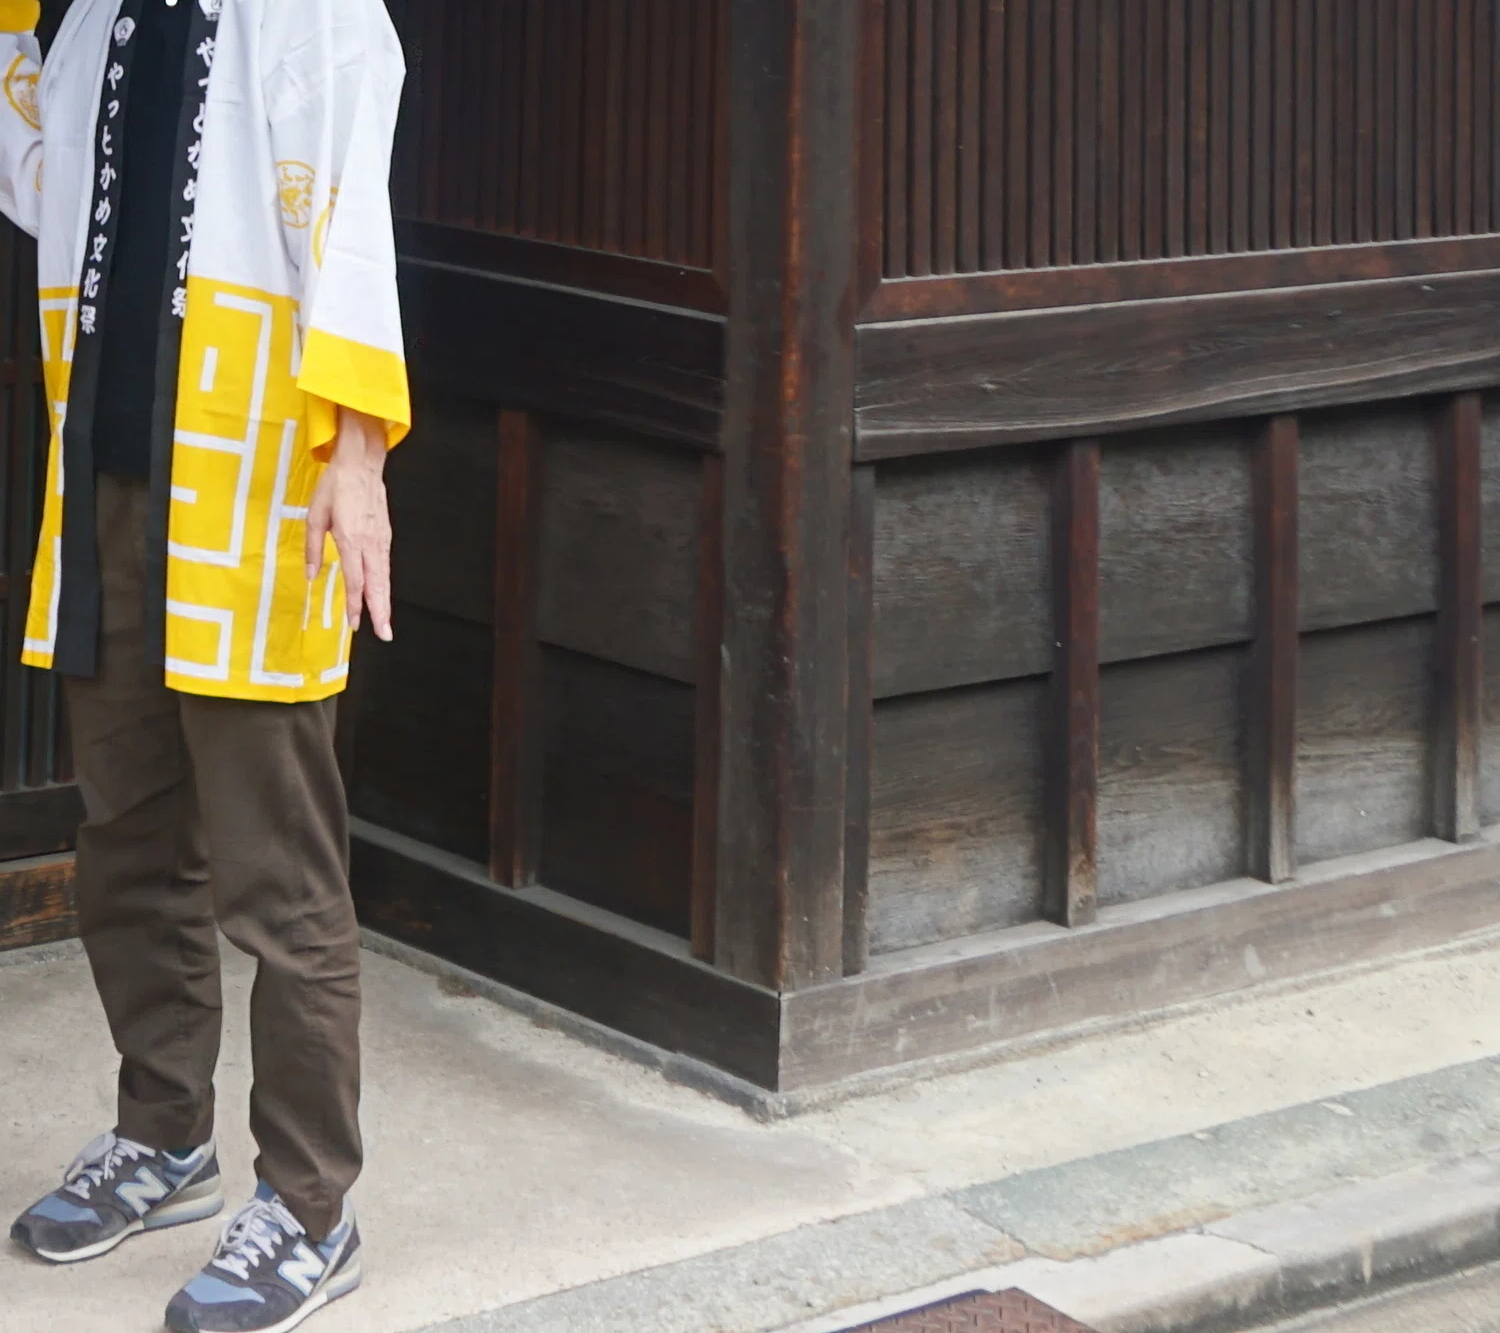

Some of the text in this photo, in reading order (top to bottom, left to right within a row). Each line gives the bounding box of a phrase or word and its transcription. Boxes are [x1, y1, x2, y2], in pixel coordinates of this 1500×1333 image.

[80, 62, 124, 334] やっとかめ文化祭
[115, 1165, 171, 1217] N
[277, 1241, 327, 1297] N
